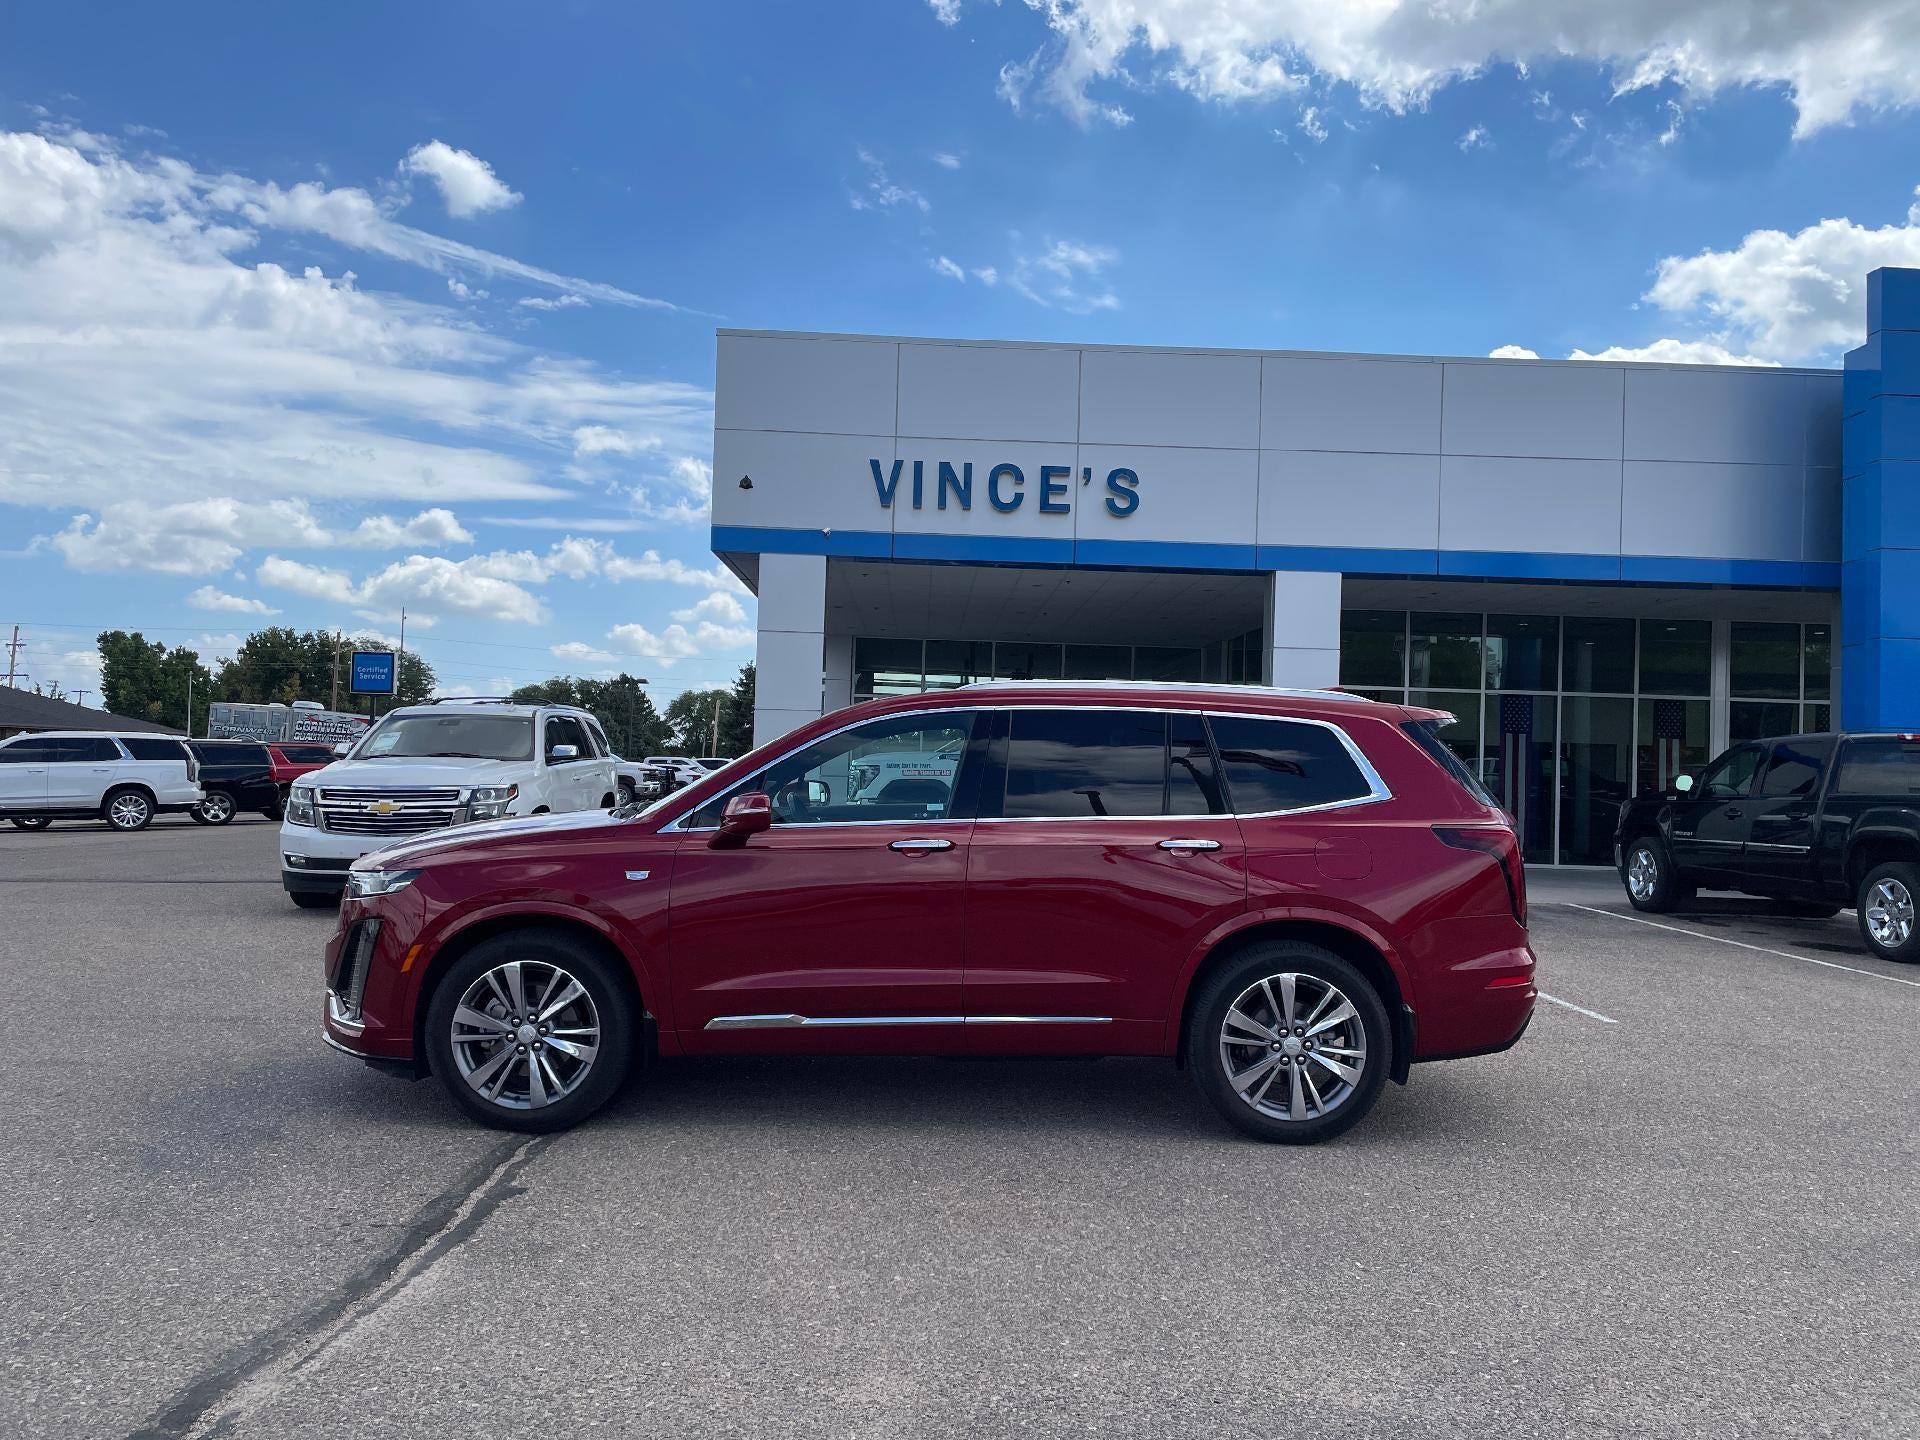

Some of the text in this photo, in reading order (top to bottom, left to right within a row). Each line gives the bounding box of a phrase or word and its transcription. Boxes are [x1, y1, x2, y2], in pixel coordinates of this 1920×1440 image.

[869, 459, 1140, 517] VINCE'S
[357, 666, 388, 674] Certified
[359, 672, 386, 680] Service
[214, 725, 275, 735] CORNWELL
[295, 720, 352, 734] CORNWELL
[294, 731, 351, 743] QUALITY TOOLS
